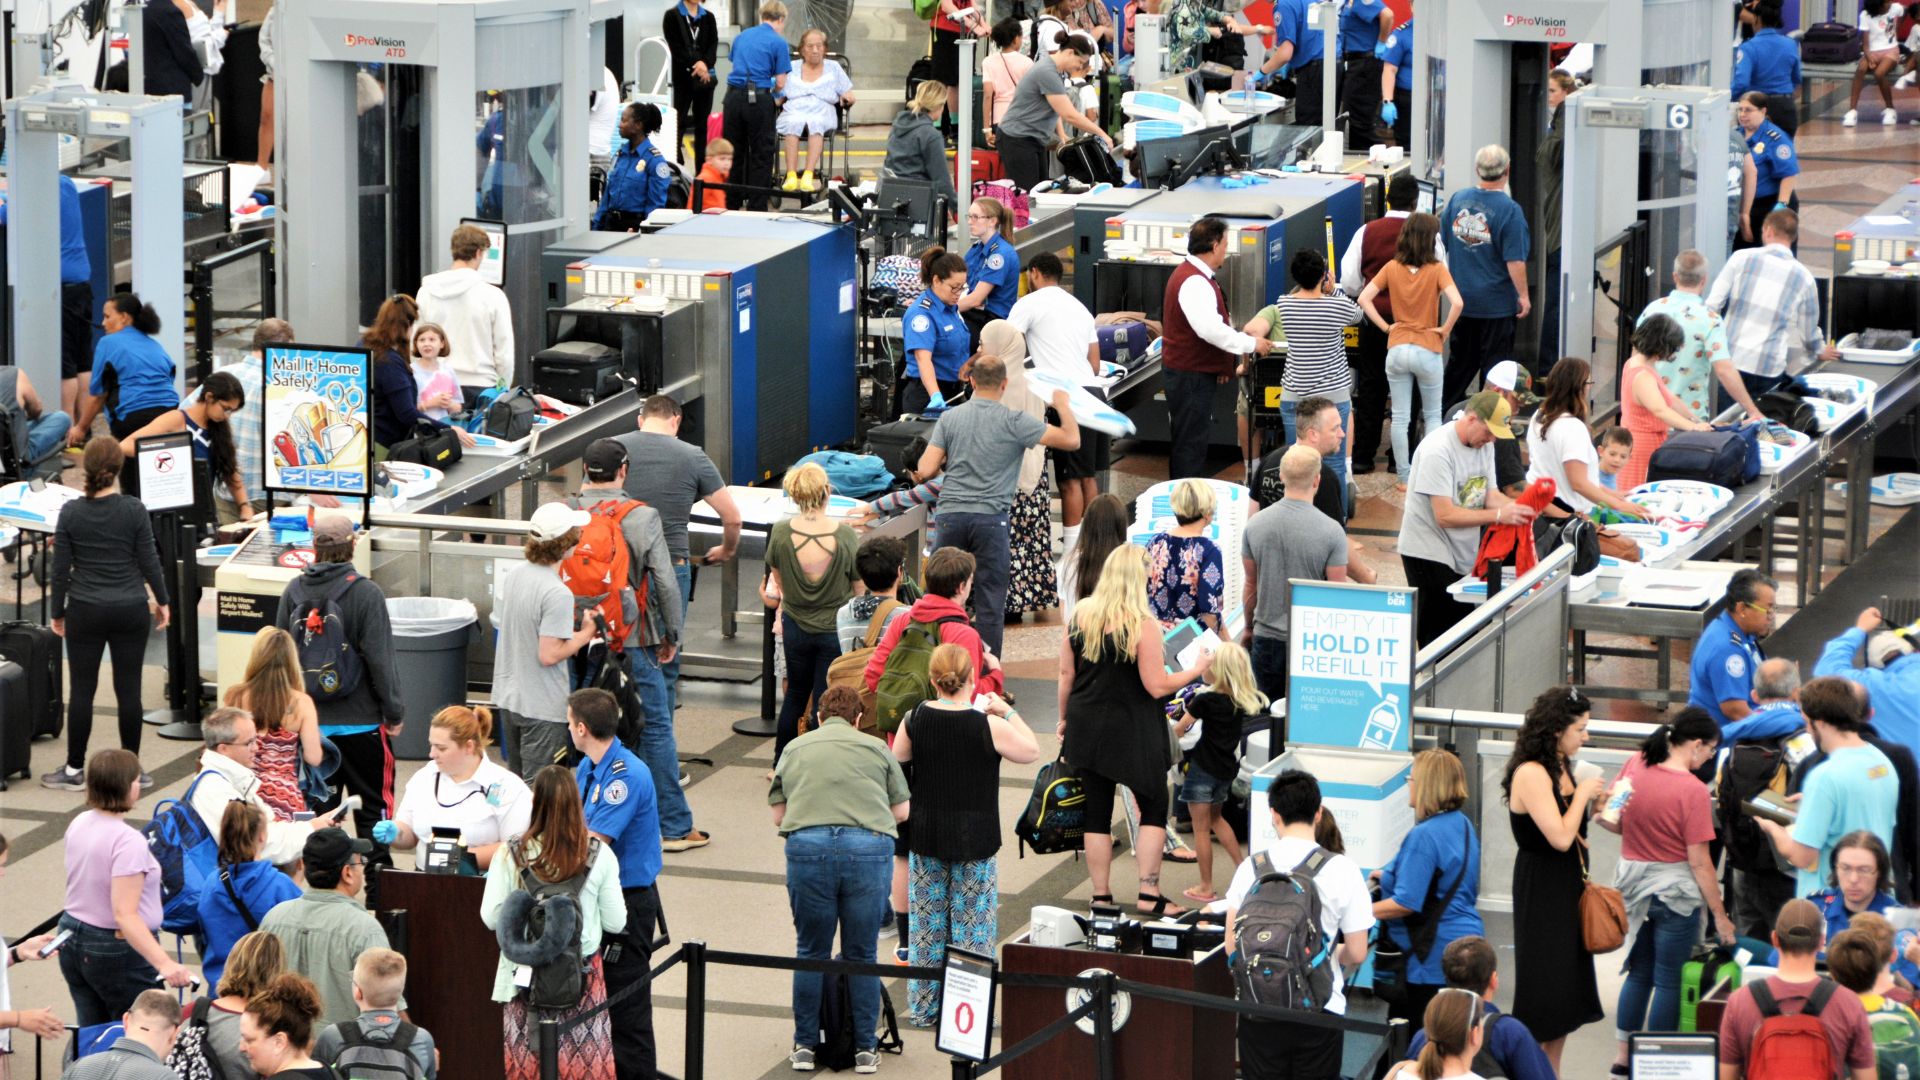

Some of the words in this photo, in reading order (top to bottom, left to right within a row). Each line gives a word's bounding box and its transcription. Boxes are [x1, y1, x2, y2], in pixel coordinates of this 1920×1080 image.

[1517, 15, 1566, 27] ProVision
[1545, 28, 1566, 37] ATD
[357, 35, 406, 47] ProVision
[386, 48, 406, 57] ATD
[1670, 104, 1689, 129] 6
[272, 357, 300, 371] Mail
[305, 359, 313, 372] It
[318, 360, 360, 375] Home
[273, 373, 317, 392] Safely!
[220, 602, 237, 610] Safely
[1387, 598, 1405, 606] DEN
[220, 609, 241, 617] Airport
[1303, 611, 1375, 633] EMPTY
[1382, 616, 1400, 634] IT
[1302, 632, 1370, 654] HOLD
[1377, 638, 1399, 656] IT
[1301, 655, 1373, 677] REFILL
[1380, 661, 1398, 678] IT
[1300, 687, 1321, 695] POUR
[1322, 688, 1337, 696] OUT
[1339, 689, 1365, 698] WATER
[1300, 695, 1316, 703] AND
[1317, 696, 1359, 706] BEVERAGES
